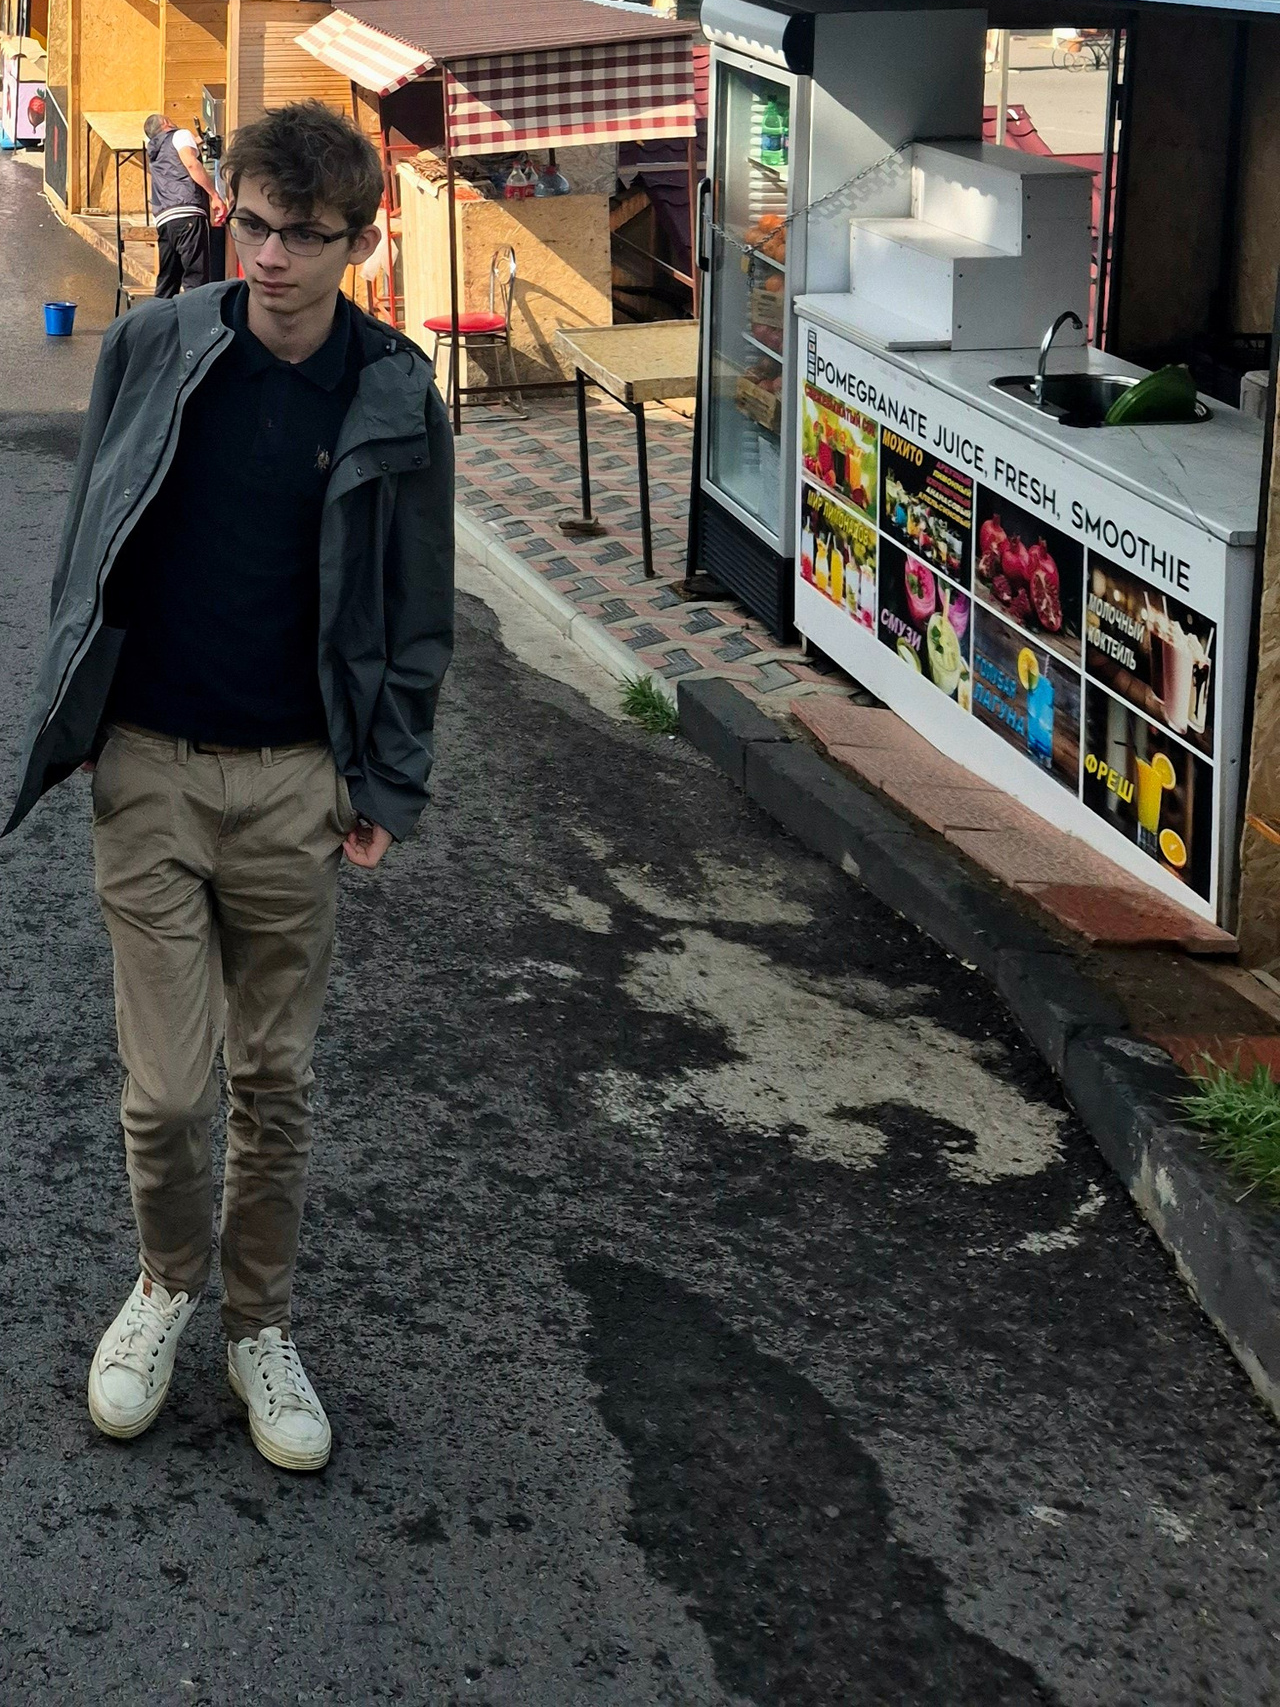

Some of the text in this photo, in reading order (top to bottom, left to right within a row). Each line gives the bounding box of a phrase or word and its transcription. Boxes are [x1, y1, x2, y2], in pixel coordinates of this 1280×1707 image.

[882, 428, 924, 466] МОХИТО
[816, 356, 1191, 592] POMEGRANATE JUICE, FRESH, SMOOTHIE
[806, 489, 823, 512] МИР
[880, 608, 922, 651] СМУЗИ
[1088, 593, 1145, 643] МОЛОЧНЫЙ
[1087, 625, 1137, 671] КОКТЕЙЛЬ
[973, 681, 1025, 735] ЛАГУНА
[1084, 754, 1135, 804] ФРЕШ
